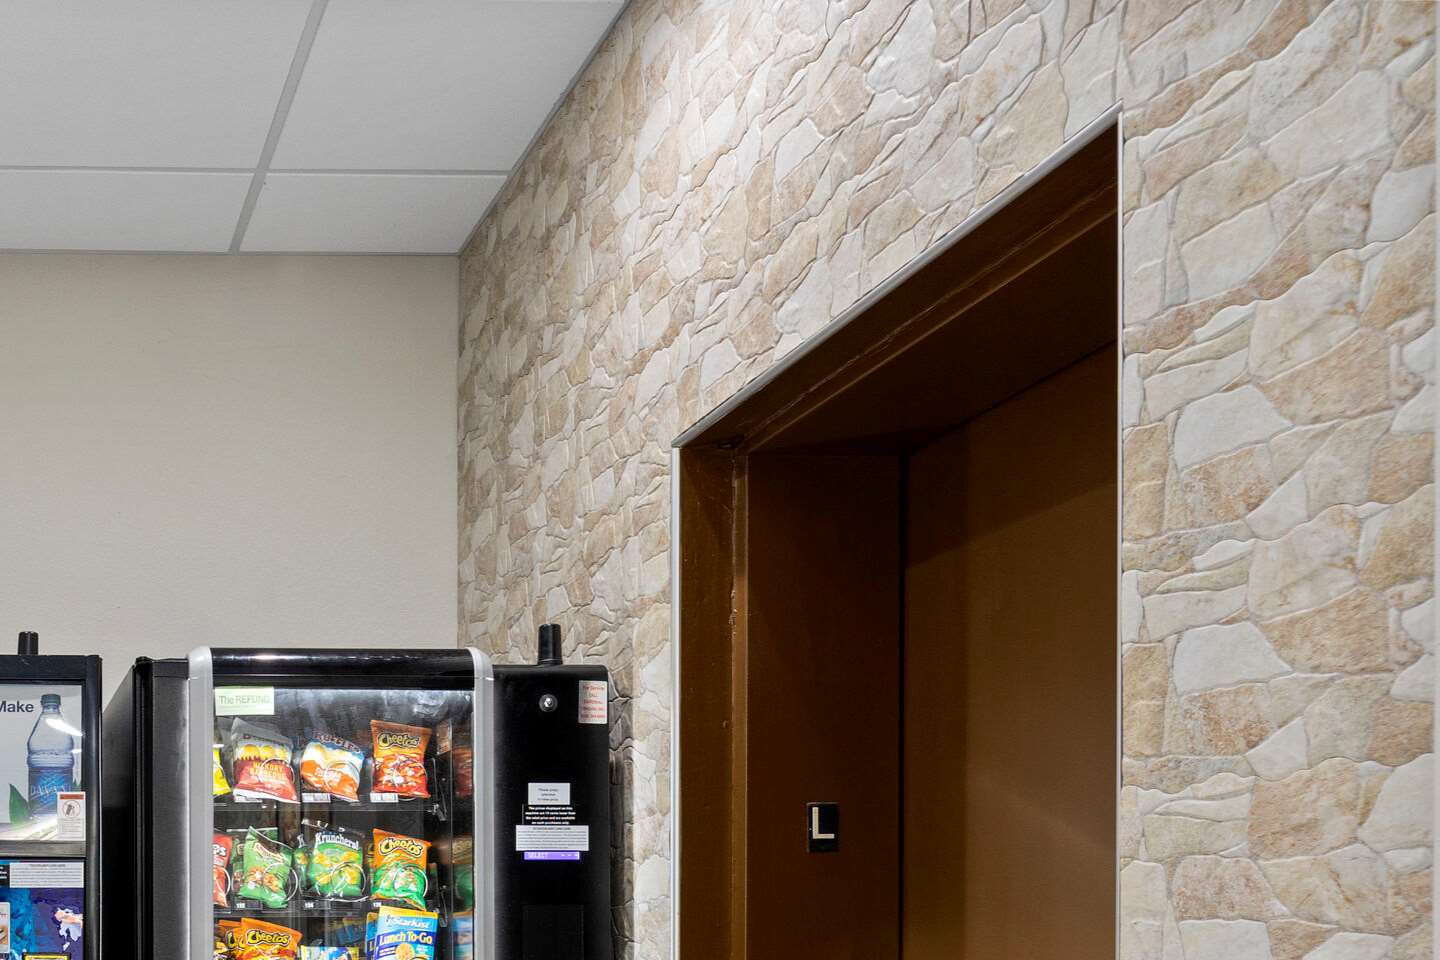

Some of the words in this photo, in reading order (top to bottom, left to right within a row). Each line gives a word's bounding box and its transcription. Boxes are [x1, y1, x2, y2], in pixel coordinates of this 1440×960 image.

[378, 732, 420, 748] Cheetos
[812, 806, 835, 839] L
[380, 837, 424, 857] Cheetos
[246, 929, 291, 946] Cheetos
[380, 931, 407, 945] Lunch
